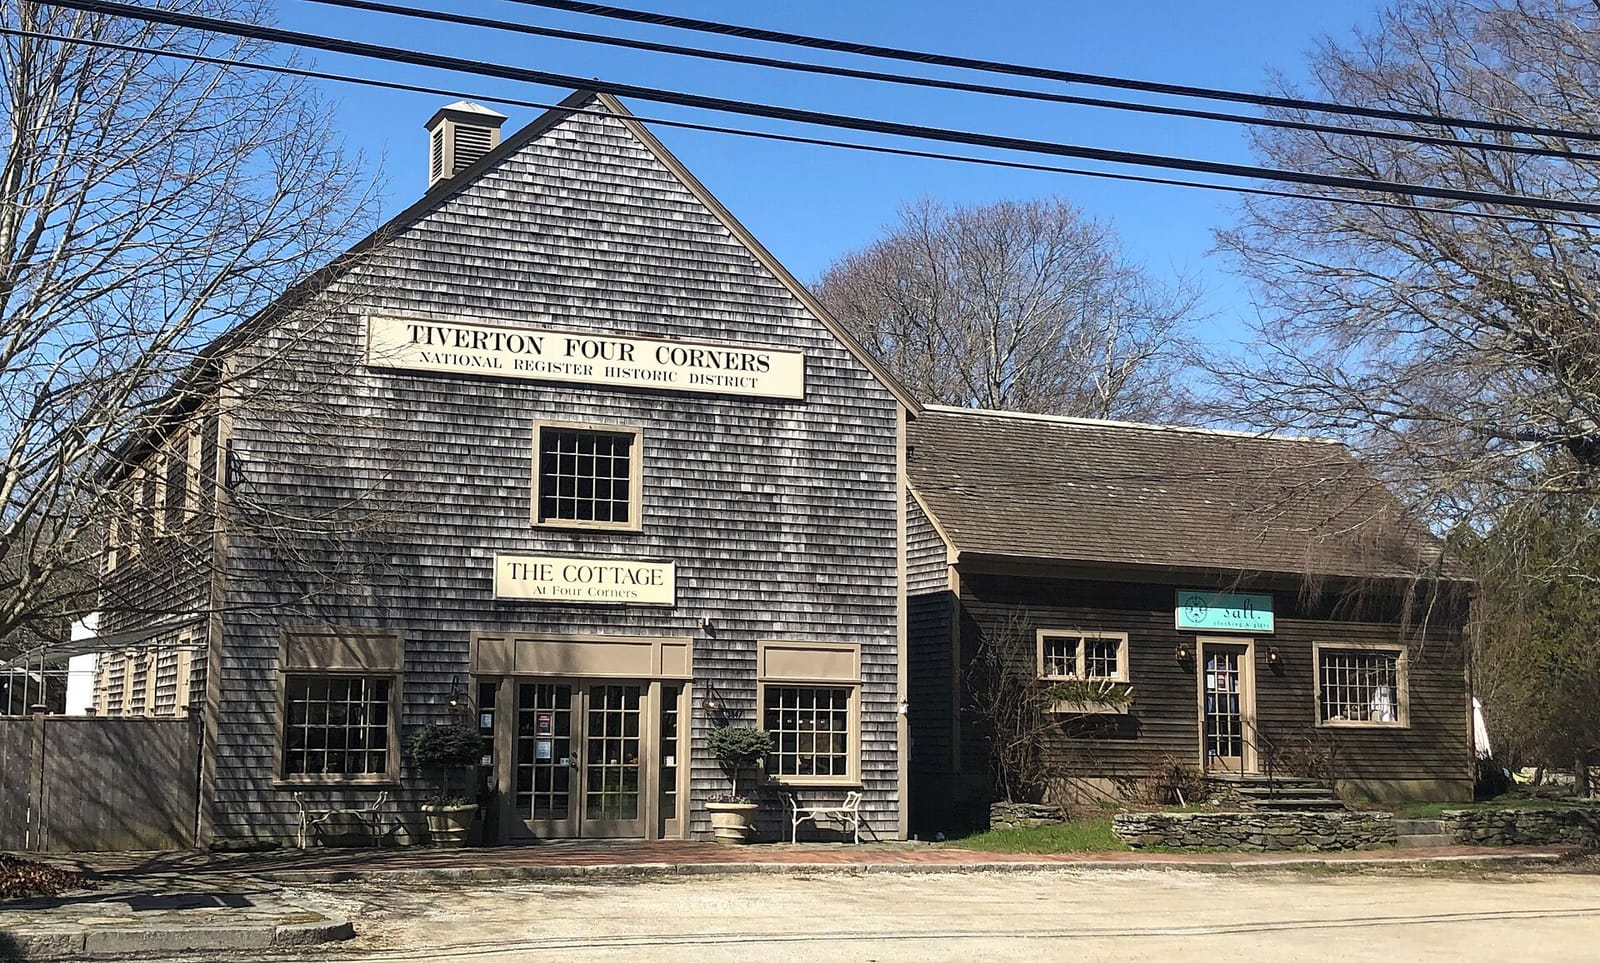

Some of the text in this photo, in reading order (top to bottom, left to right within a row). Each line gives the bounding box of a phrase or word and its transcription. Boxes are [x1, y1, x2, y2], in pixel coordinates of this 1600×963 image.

[407, 325, 770, 373] TIVERTON FOUR CORNERS
[419, 351, 759, 389] NATIONAL REGISTER HISTORIC DISTRICT
[507, 562, 664, 586] THE COTTAGE
[533, 585, 638, 598] At Four Corners
